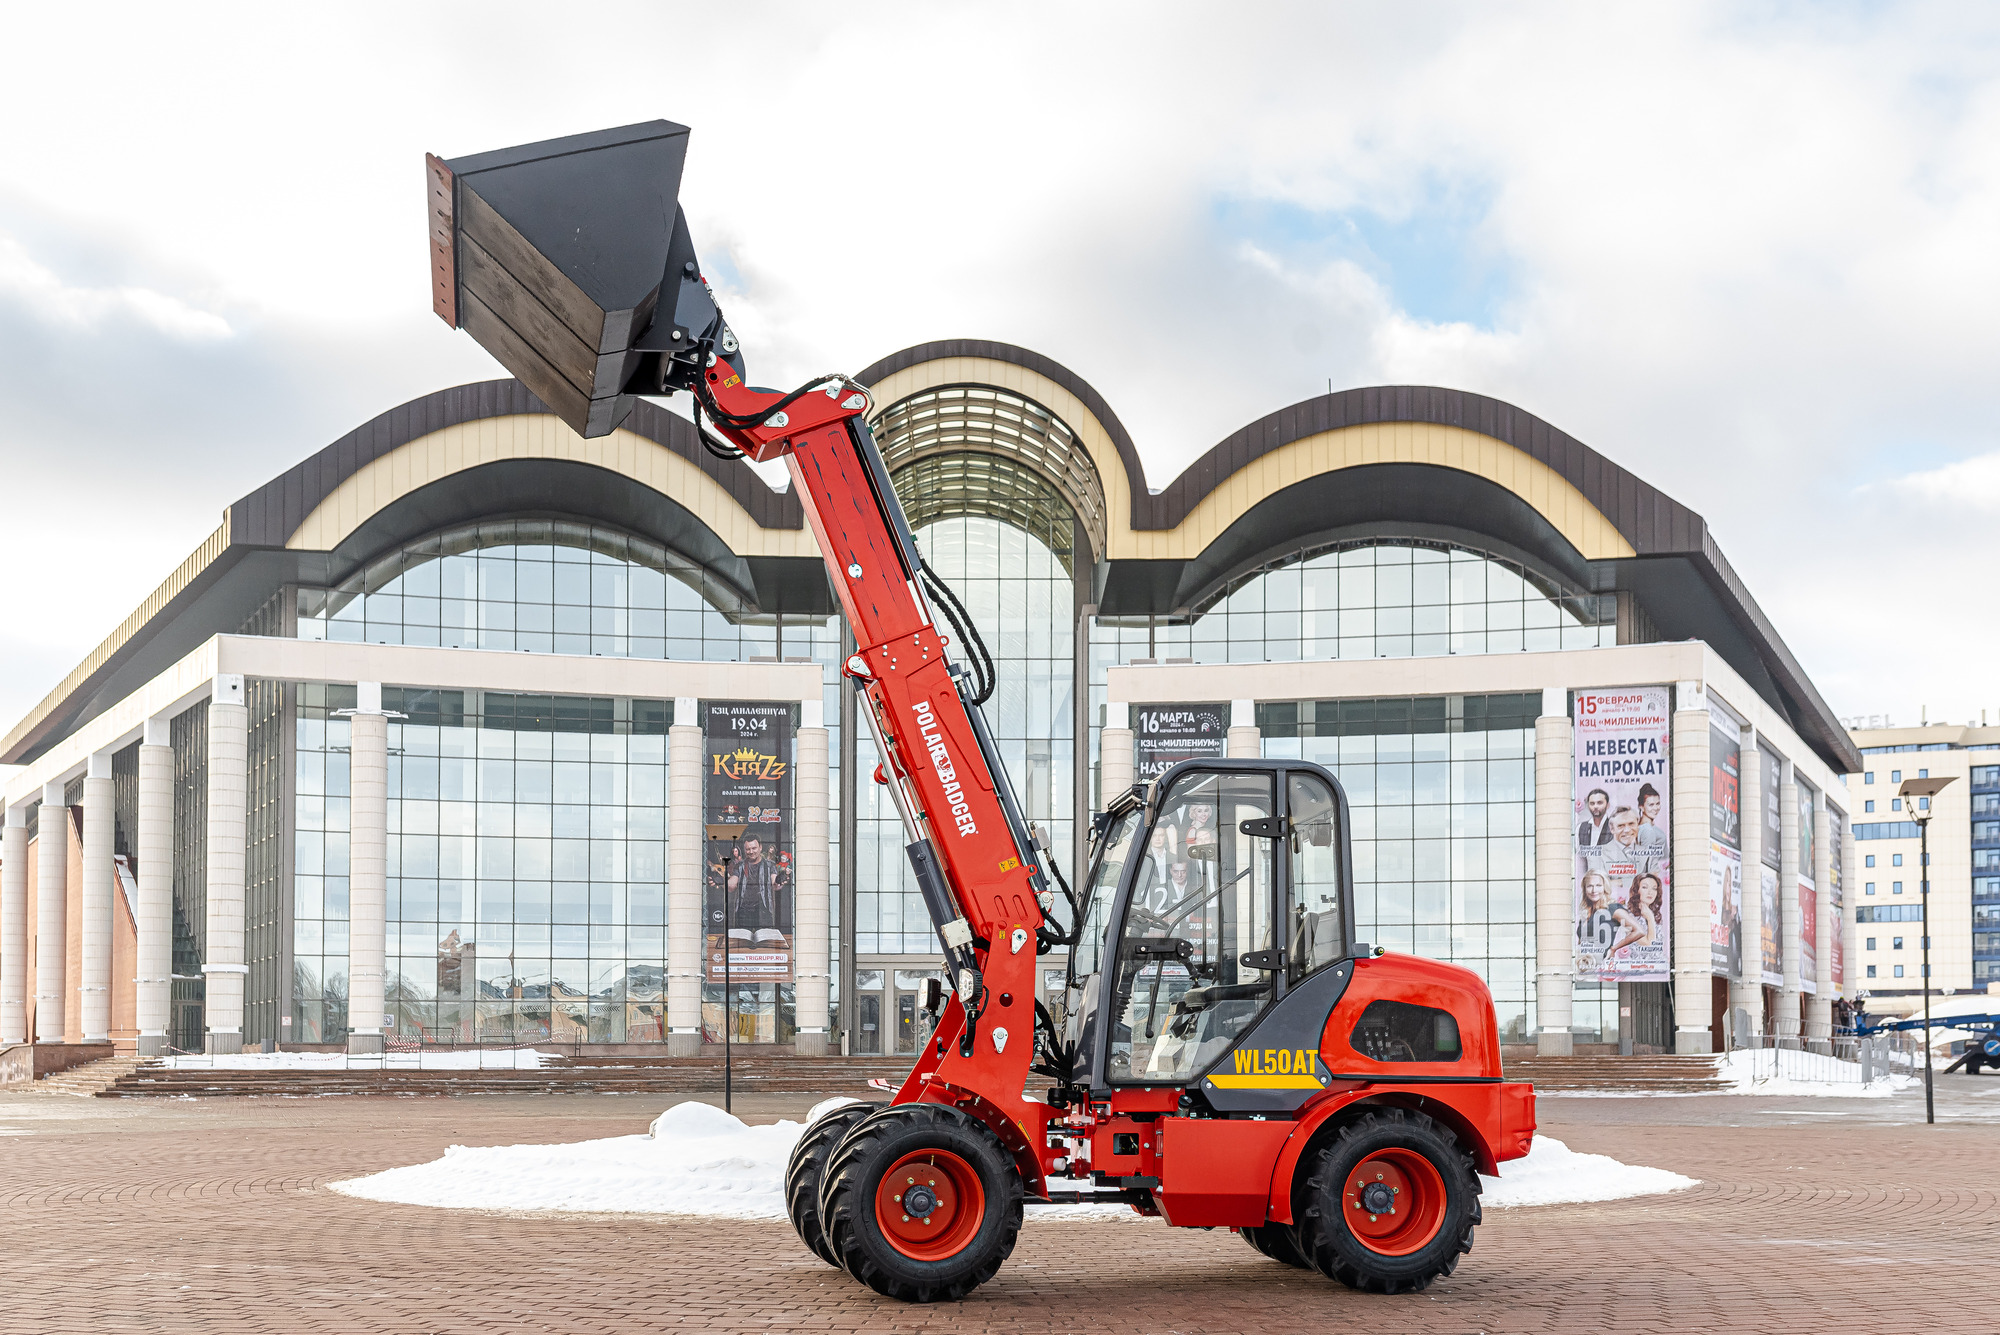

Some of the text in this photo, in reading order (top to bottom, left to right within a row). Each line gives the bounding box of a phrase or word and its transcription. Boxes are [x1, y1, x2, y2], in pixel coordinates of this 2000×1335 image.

[712, 707, 786, 716] КЗЦ МИЛЛЕНИУМ
[1578, 696, 1596, 714] 15
[1597, 695, 1642, 704] ФЕВРАЛЯ
[731, 718, 767, 730] 19.04
[1140, 712, 1159, 733] 16
[1160, 712, 1195, 722] МАРТА
[1580, 716, 1665, 727] КЗЦ «МИЛЛЕНИУМ»
[1141, 739, 1219, 748] КЗЦ «МИЛЛЕНИУМ»
[1586, 738, 1657, 756] НЕВЕСТА
[912, 701, 976, 838] POLAR BADGER
[1579, 759, 1665, 777] НАПРОКАТ
[1234, 1049, 1318, 1074] WL50AT
